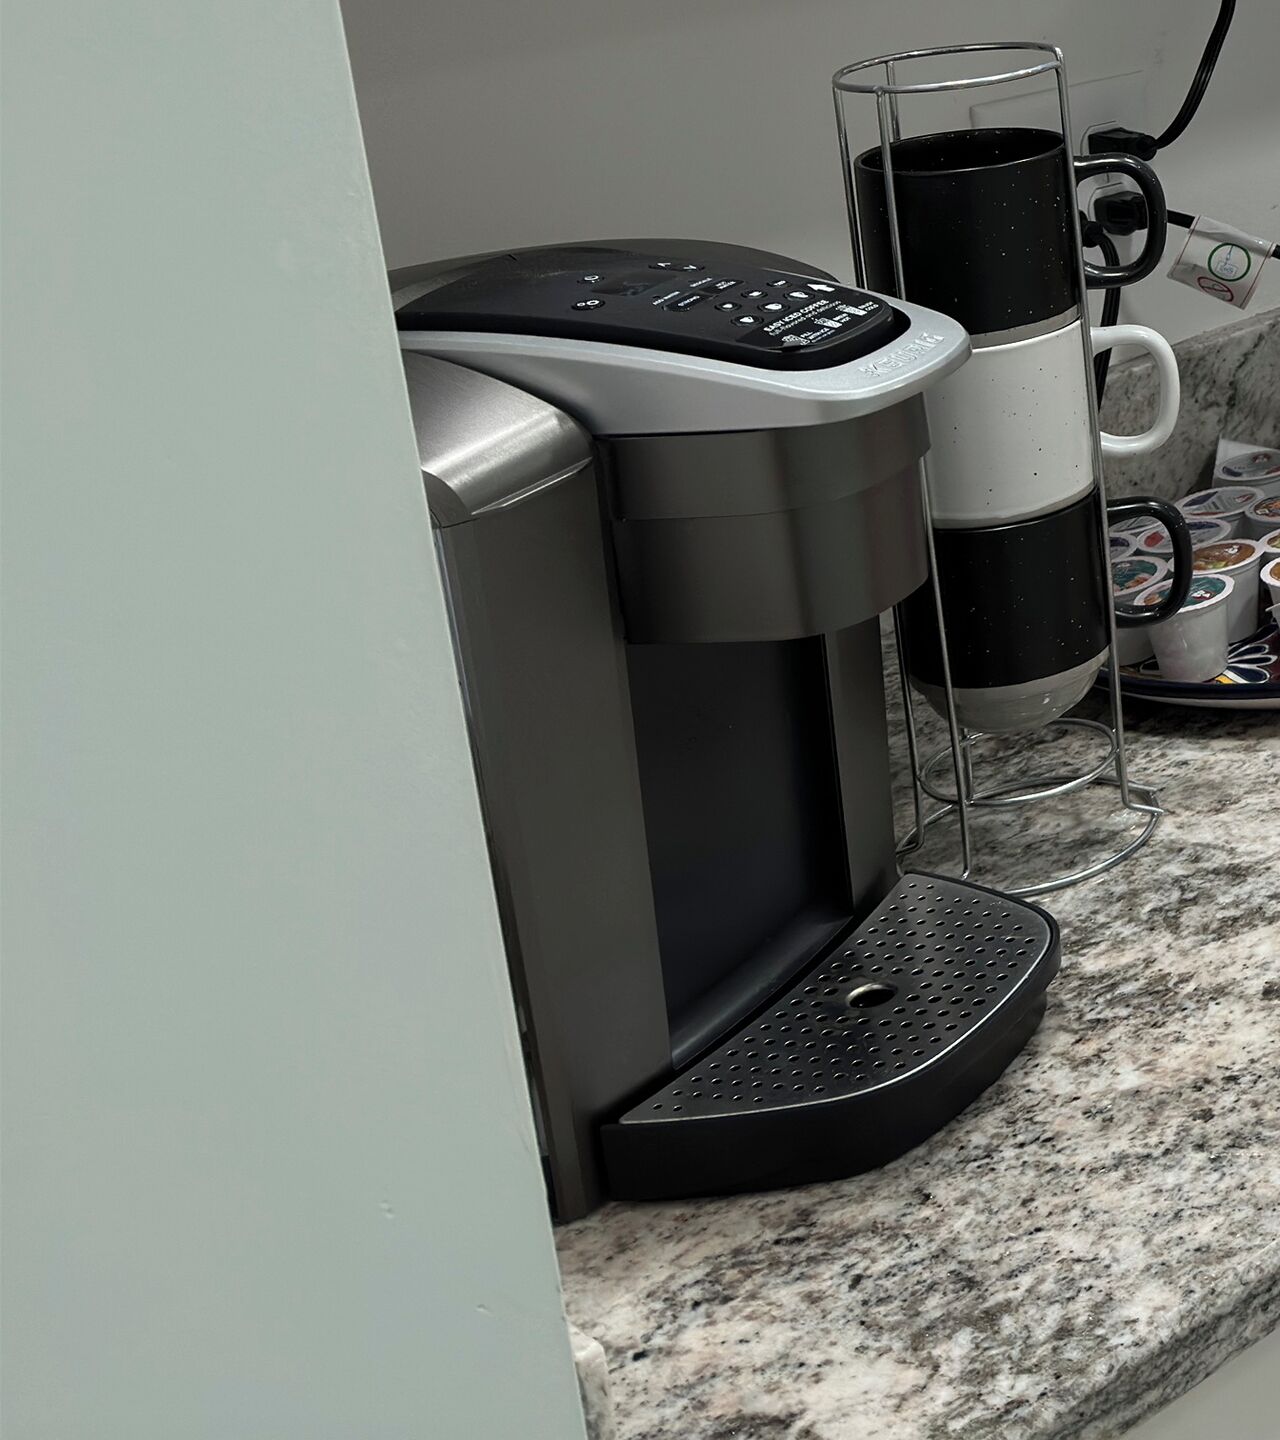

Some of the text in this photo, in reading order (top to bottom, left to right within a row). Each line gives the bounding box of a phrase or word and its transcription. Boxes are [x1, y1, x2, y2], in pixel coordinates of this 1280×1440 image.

[763, 299, 830, 332] EASY ICED COFFEE
[858, 331, 945, 376] KEURIG
